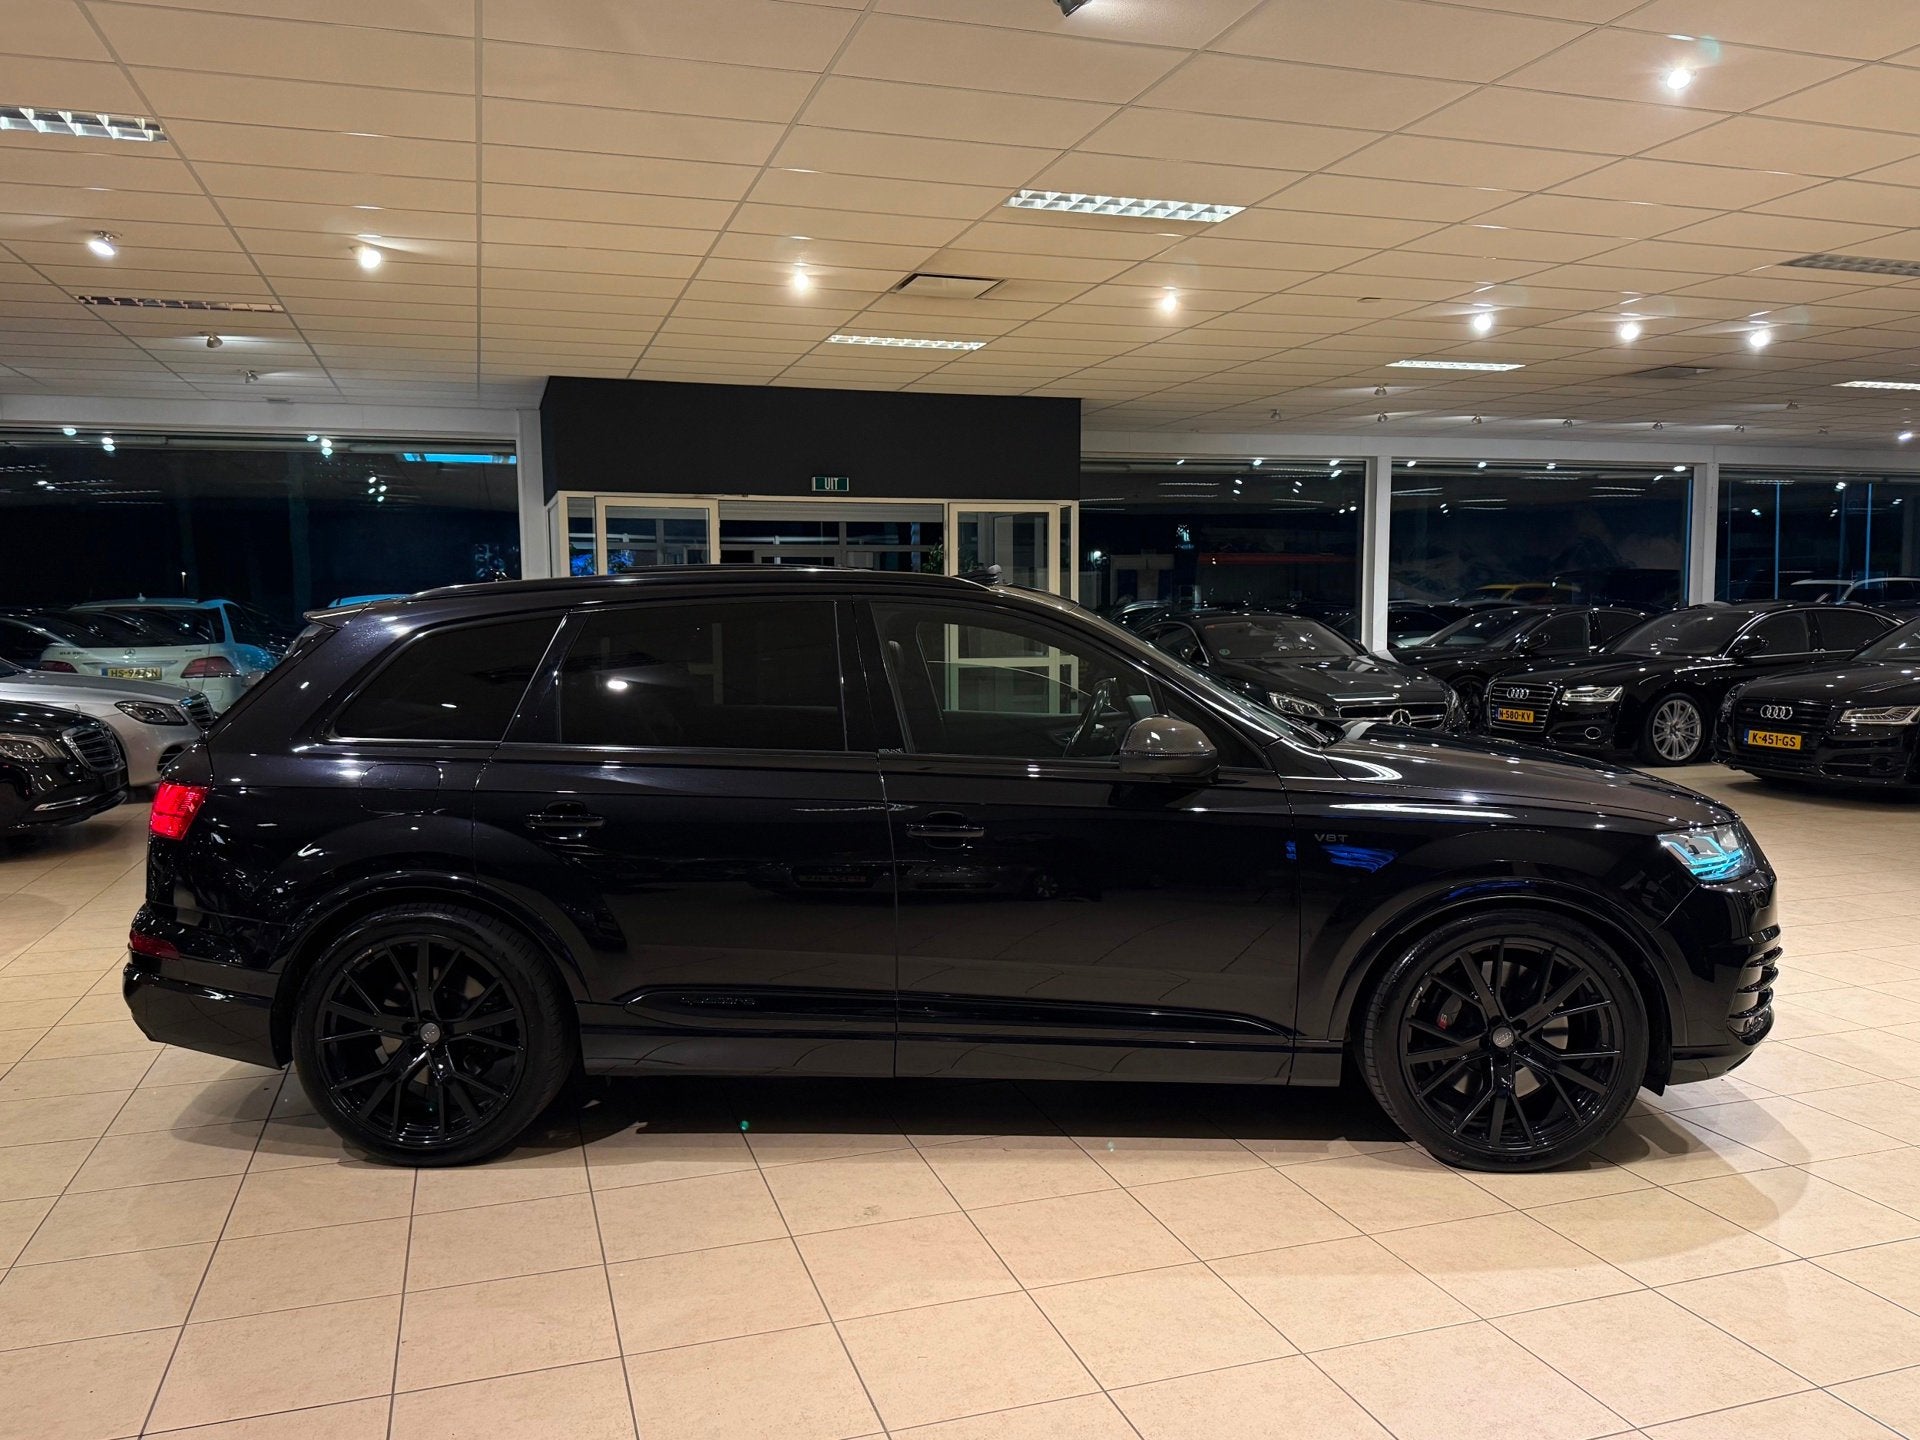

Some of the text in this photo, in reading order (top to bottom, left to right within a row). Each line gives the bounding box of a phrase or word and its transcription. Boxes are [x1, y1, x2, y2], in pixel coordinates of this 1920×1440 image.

[824, 477, 839, 490] UIT
[1499, 709, 1531, 721] N-580-KV
[1752, 732, 1796, 747] K-451-GS
[1314, 833, 1349, 843] V8T
